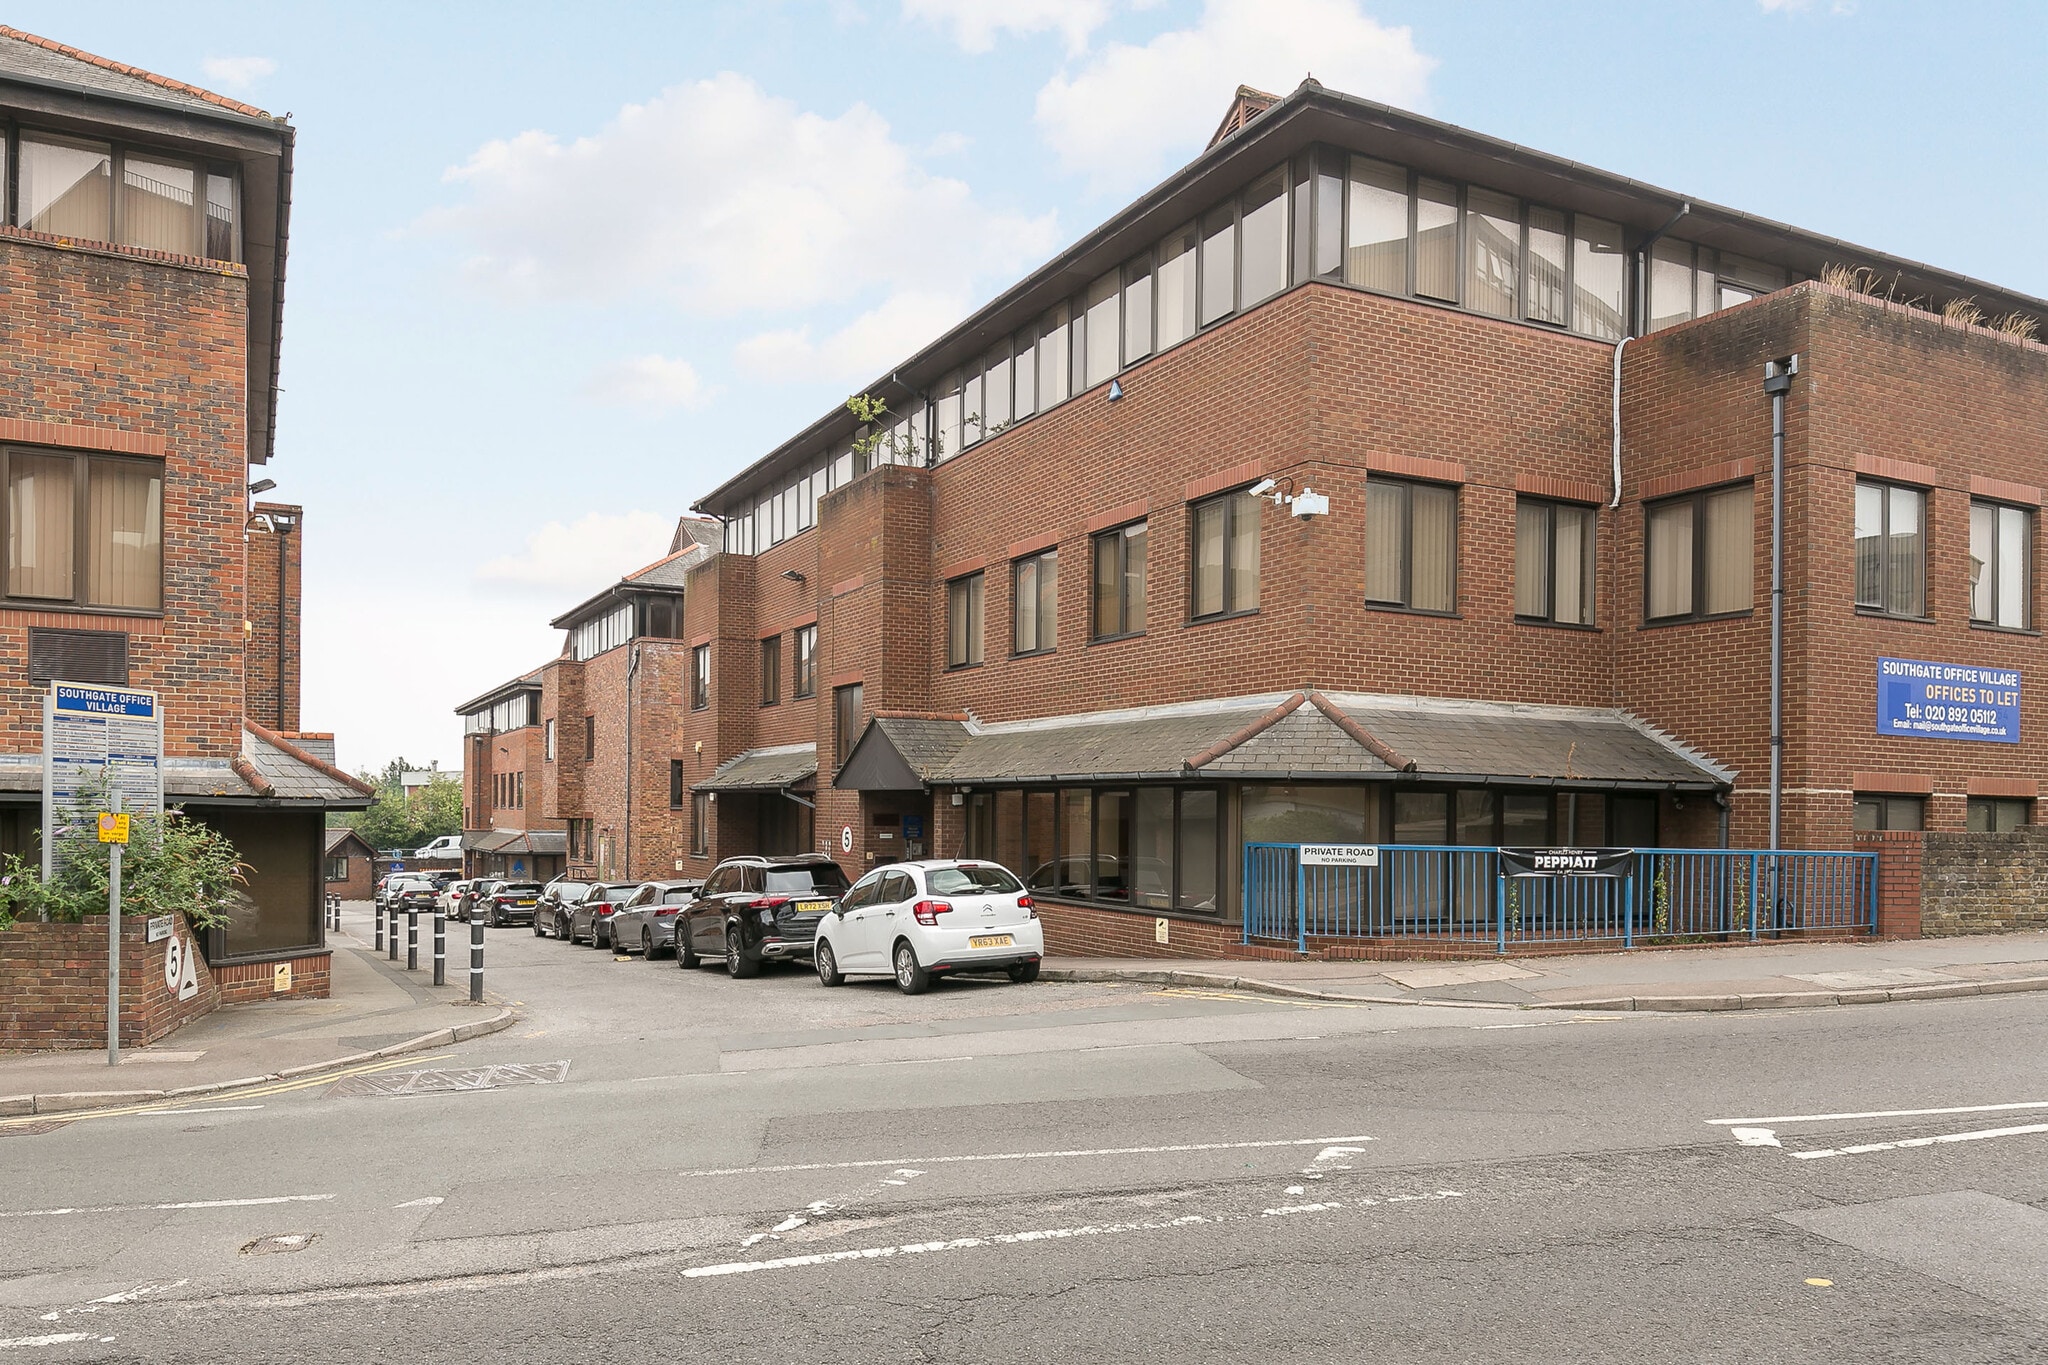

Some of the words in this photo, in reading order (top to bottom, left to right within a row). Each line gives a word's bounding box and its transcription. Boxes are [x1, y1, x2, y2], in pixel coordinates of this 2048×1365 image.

[1882, 661, 1942, 679] SOUTHGATE
[1944, 667, 1978, 682] OFFICE
[1979, 670, 2018, 687] VILLAGE
[59, 688, 117, 702] SOUTHGATE
[119, 694, 152, 706] OFFICE
[1926, 684, 1976, 703] OFFICES
[1979, 689, 1994, 704] TO
[1997, 691, 2019, 706] LET
[86, 701, 126, 714] VILLAGE
[1904, 703, 1922, 719] Tel:
[1925, 705, 1946, 721] 020
[1948, 707, 1968, 723] 892
[1970, 709, 1997, 725] 05112
[1893, 719, 1912, 729] Email:
[844, 831, 850, 848] 5
[1304, 847, 1344, 856] PRIVATE
[1346, 848, 1374, 857] ROAD
[1534, 856, 1598, 868] PEPPIATT
[973, 937, 993, 947] YR63
[995, 936, 1008, 945] XAE
[170, 945, 178, 978] 5
